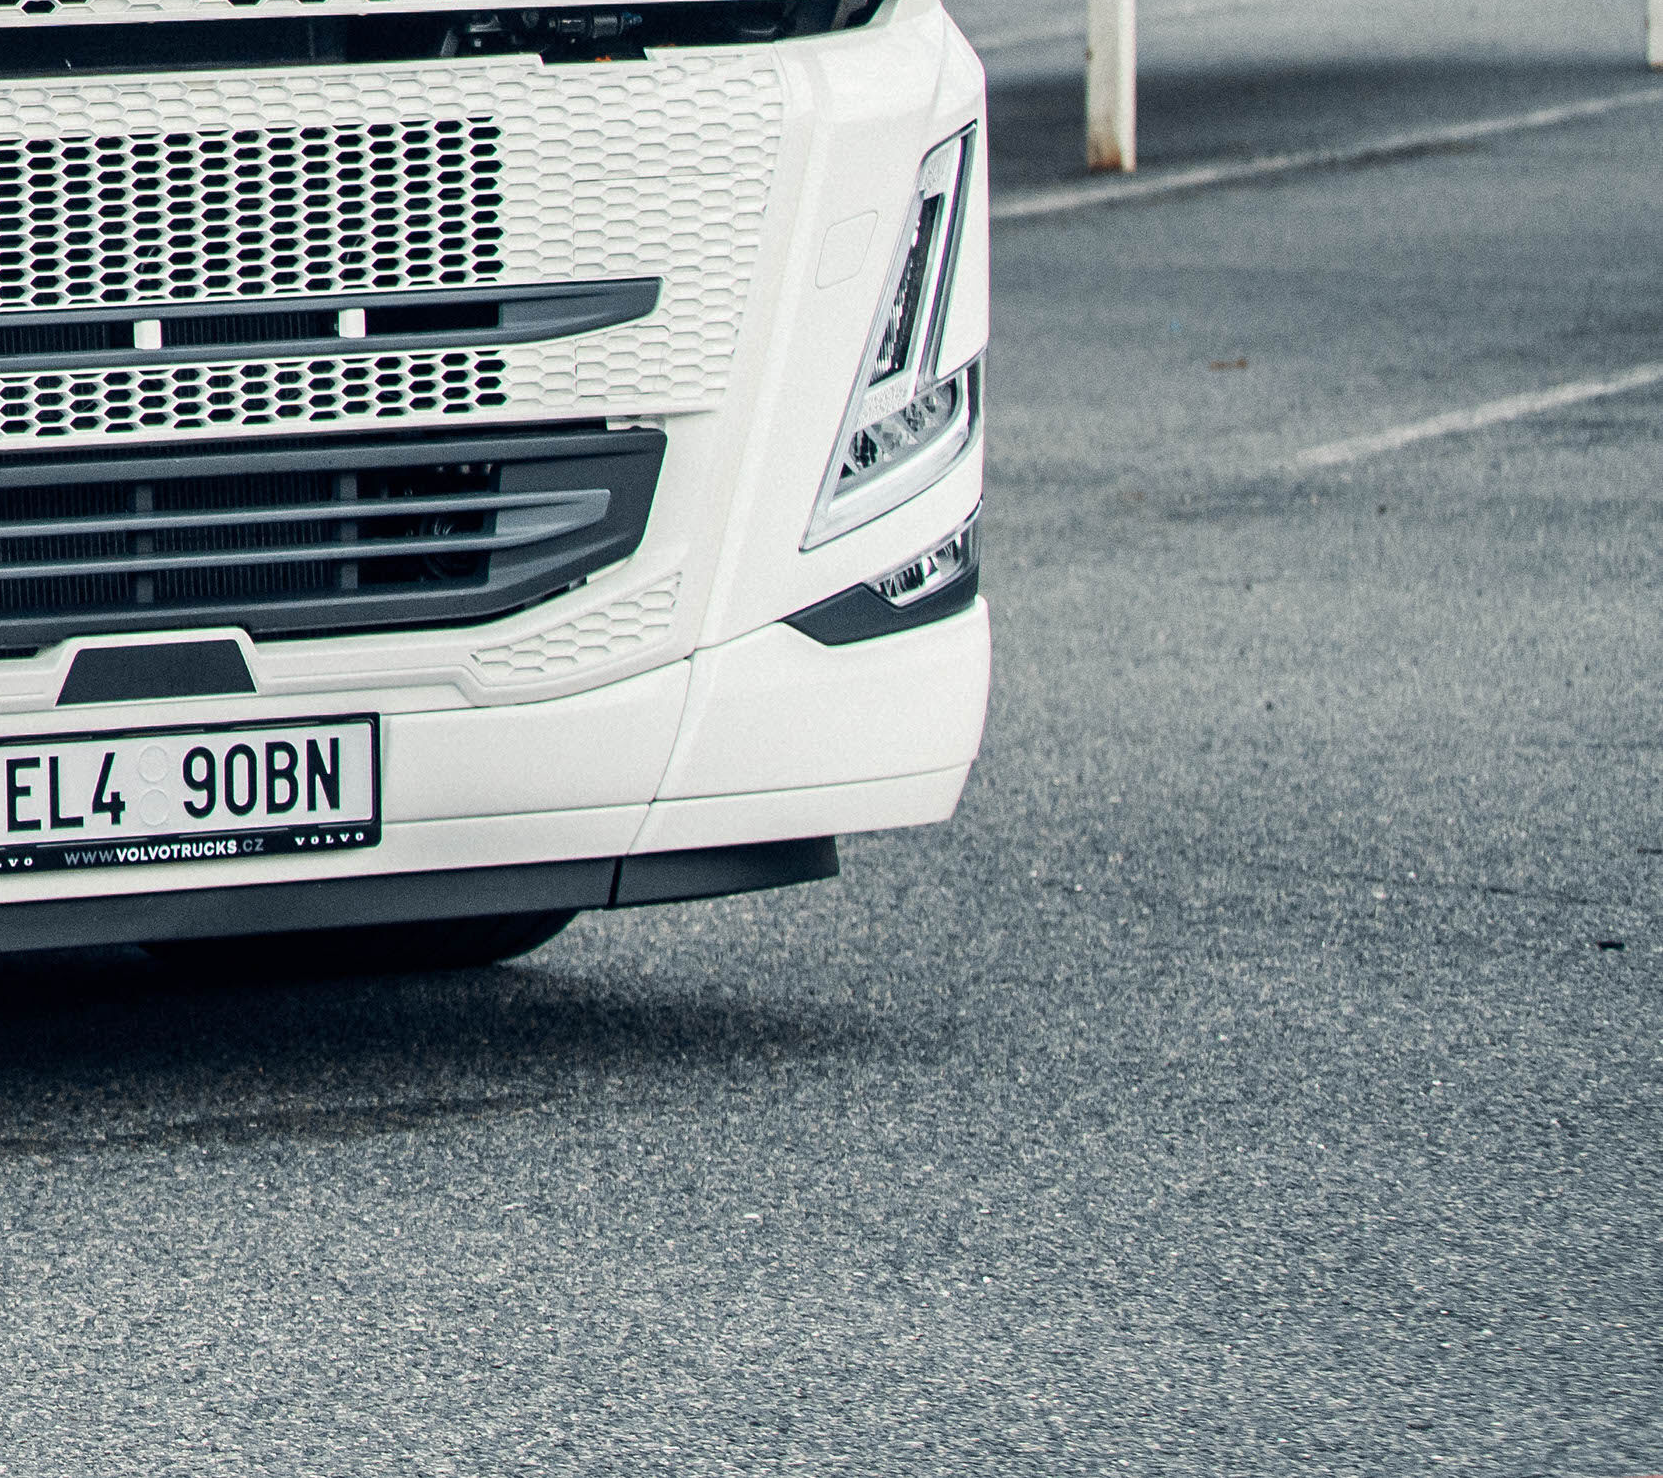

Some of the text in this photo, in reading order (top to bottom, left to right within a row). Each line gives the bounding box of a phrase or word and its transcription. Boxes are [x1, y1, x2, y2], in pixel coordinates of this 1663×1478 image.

[5, 736, 341, 833] EL4 90BN
[64, 837, 265, 866] WWW.VOLVOTRUCKS.CZ
[294, 831, 365, 846] VOLVO
